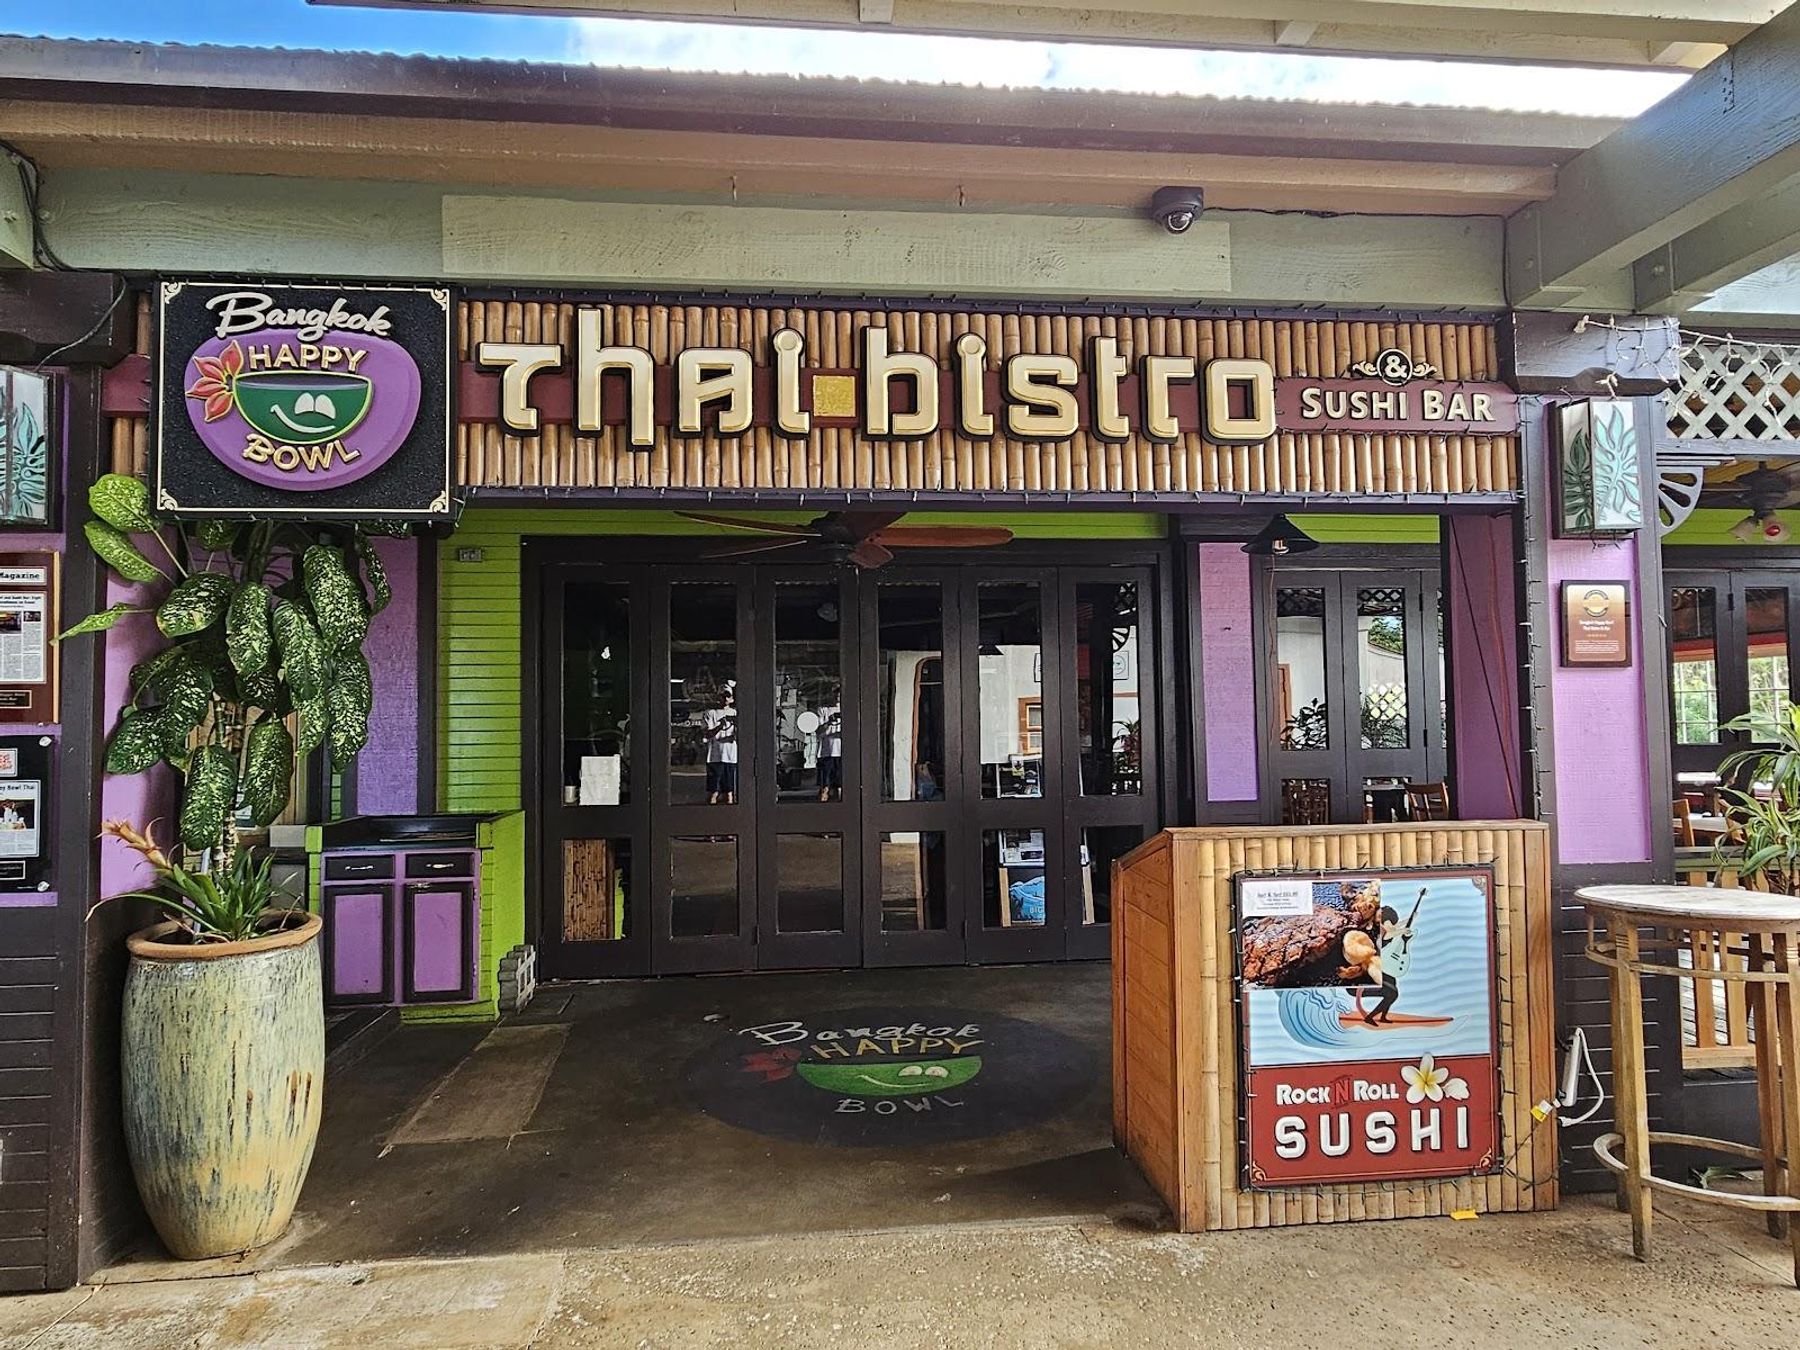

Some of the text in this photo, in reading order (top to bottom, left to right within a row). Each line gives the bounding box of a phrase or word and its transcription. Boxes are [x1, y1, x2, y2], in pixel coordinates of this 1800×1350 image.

[205, 291, 392, 342] Bangkok
[248, 343, 368, 373] HAPPY
[1384, 355, 1408, 378] &
[1302, 387, 1496, 421] SUSHI BAR
[242, 433, 361, 472] BOWL
[738, 1021, 982, 1046] Bangkok
[810, 1037, 985, 1059] HAPPY
[835, 1095, 965, 1115] BOWL
[1276, 1077, 1400, 1107] ROCK N ROLL
[1275, 1106, 1469, 1159] SUSHI
